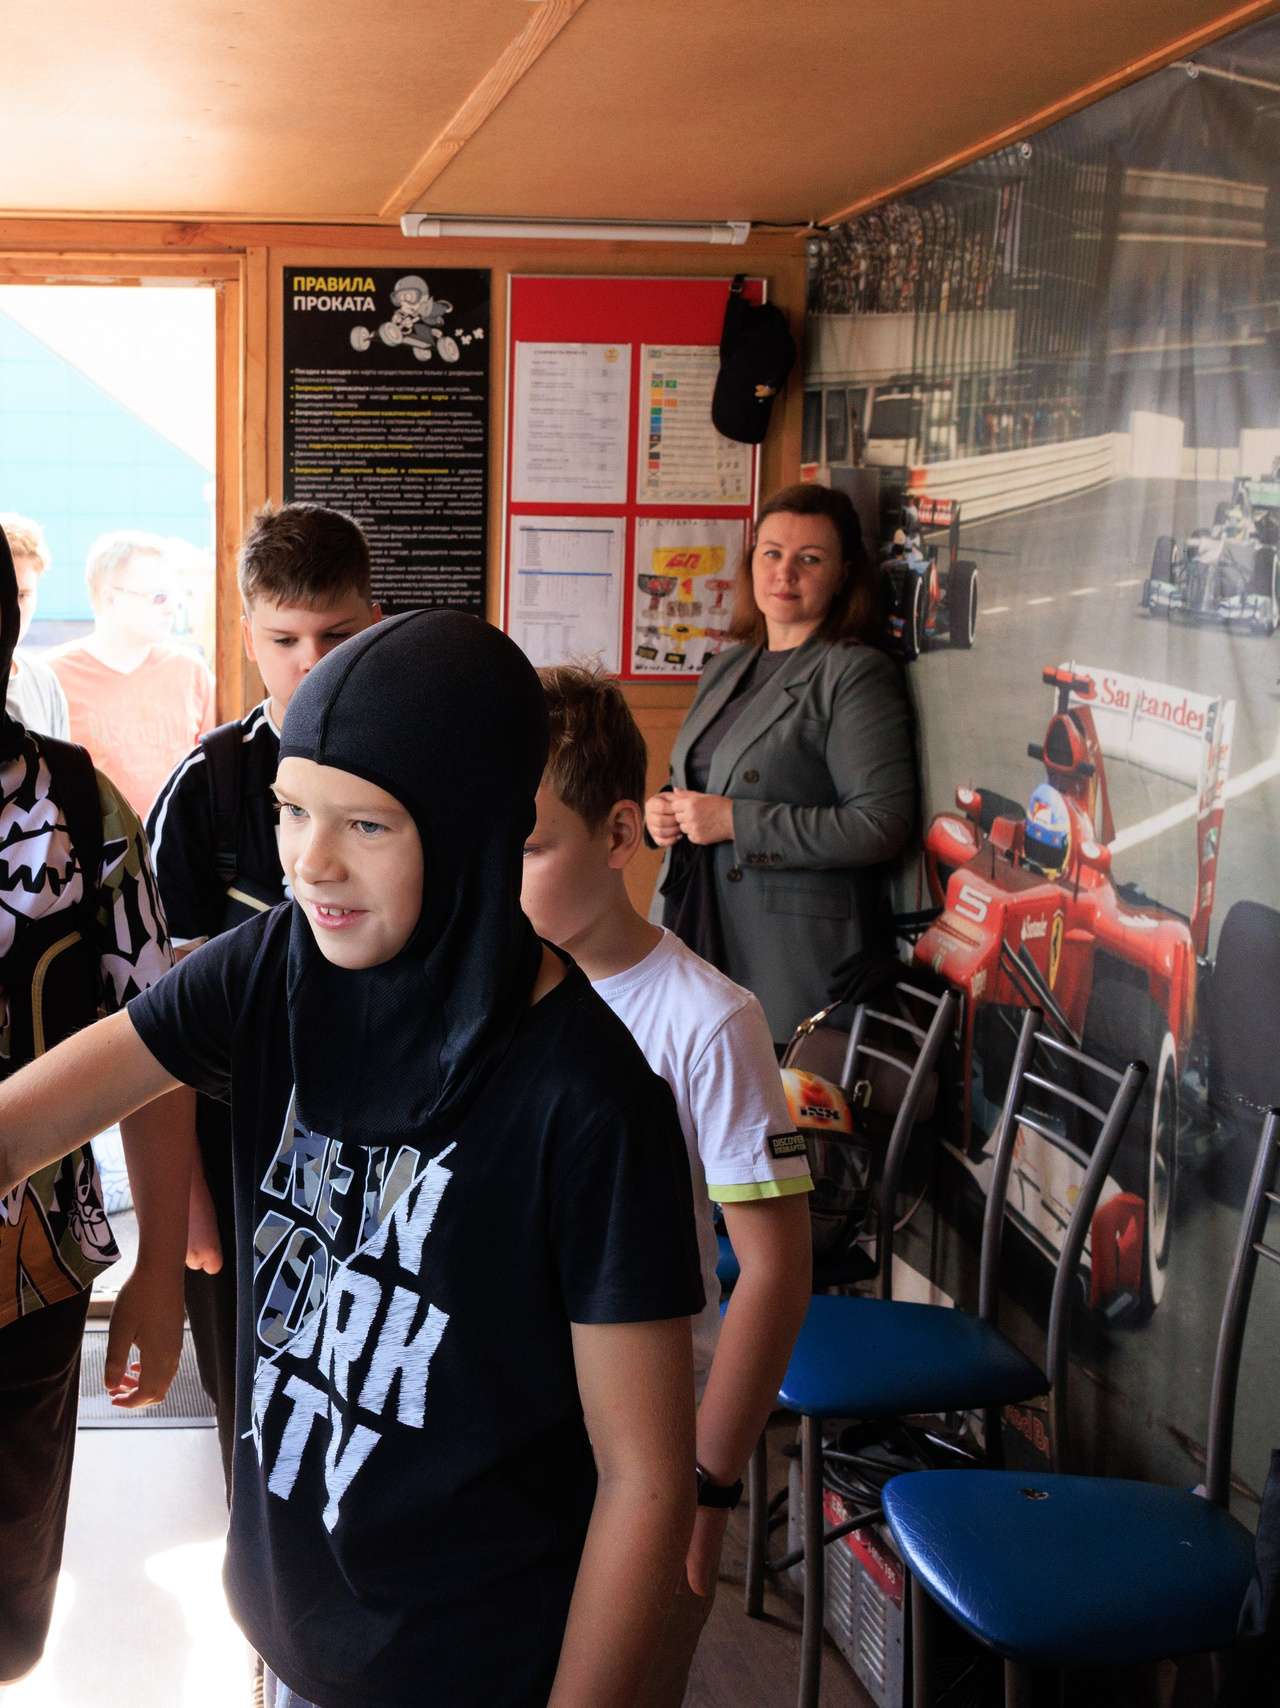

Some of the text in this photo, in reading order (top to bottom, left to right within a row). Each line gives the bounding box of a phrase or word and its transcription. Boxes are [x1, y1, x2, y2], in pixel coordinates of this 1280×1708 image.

[293, 276, 376, 292] ПРАВИЛА
[293, 296, 376, 312] ПРОКАТА
[954, 884, 993, 923] 5
